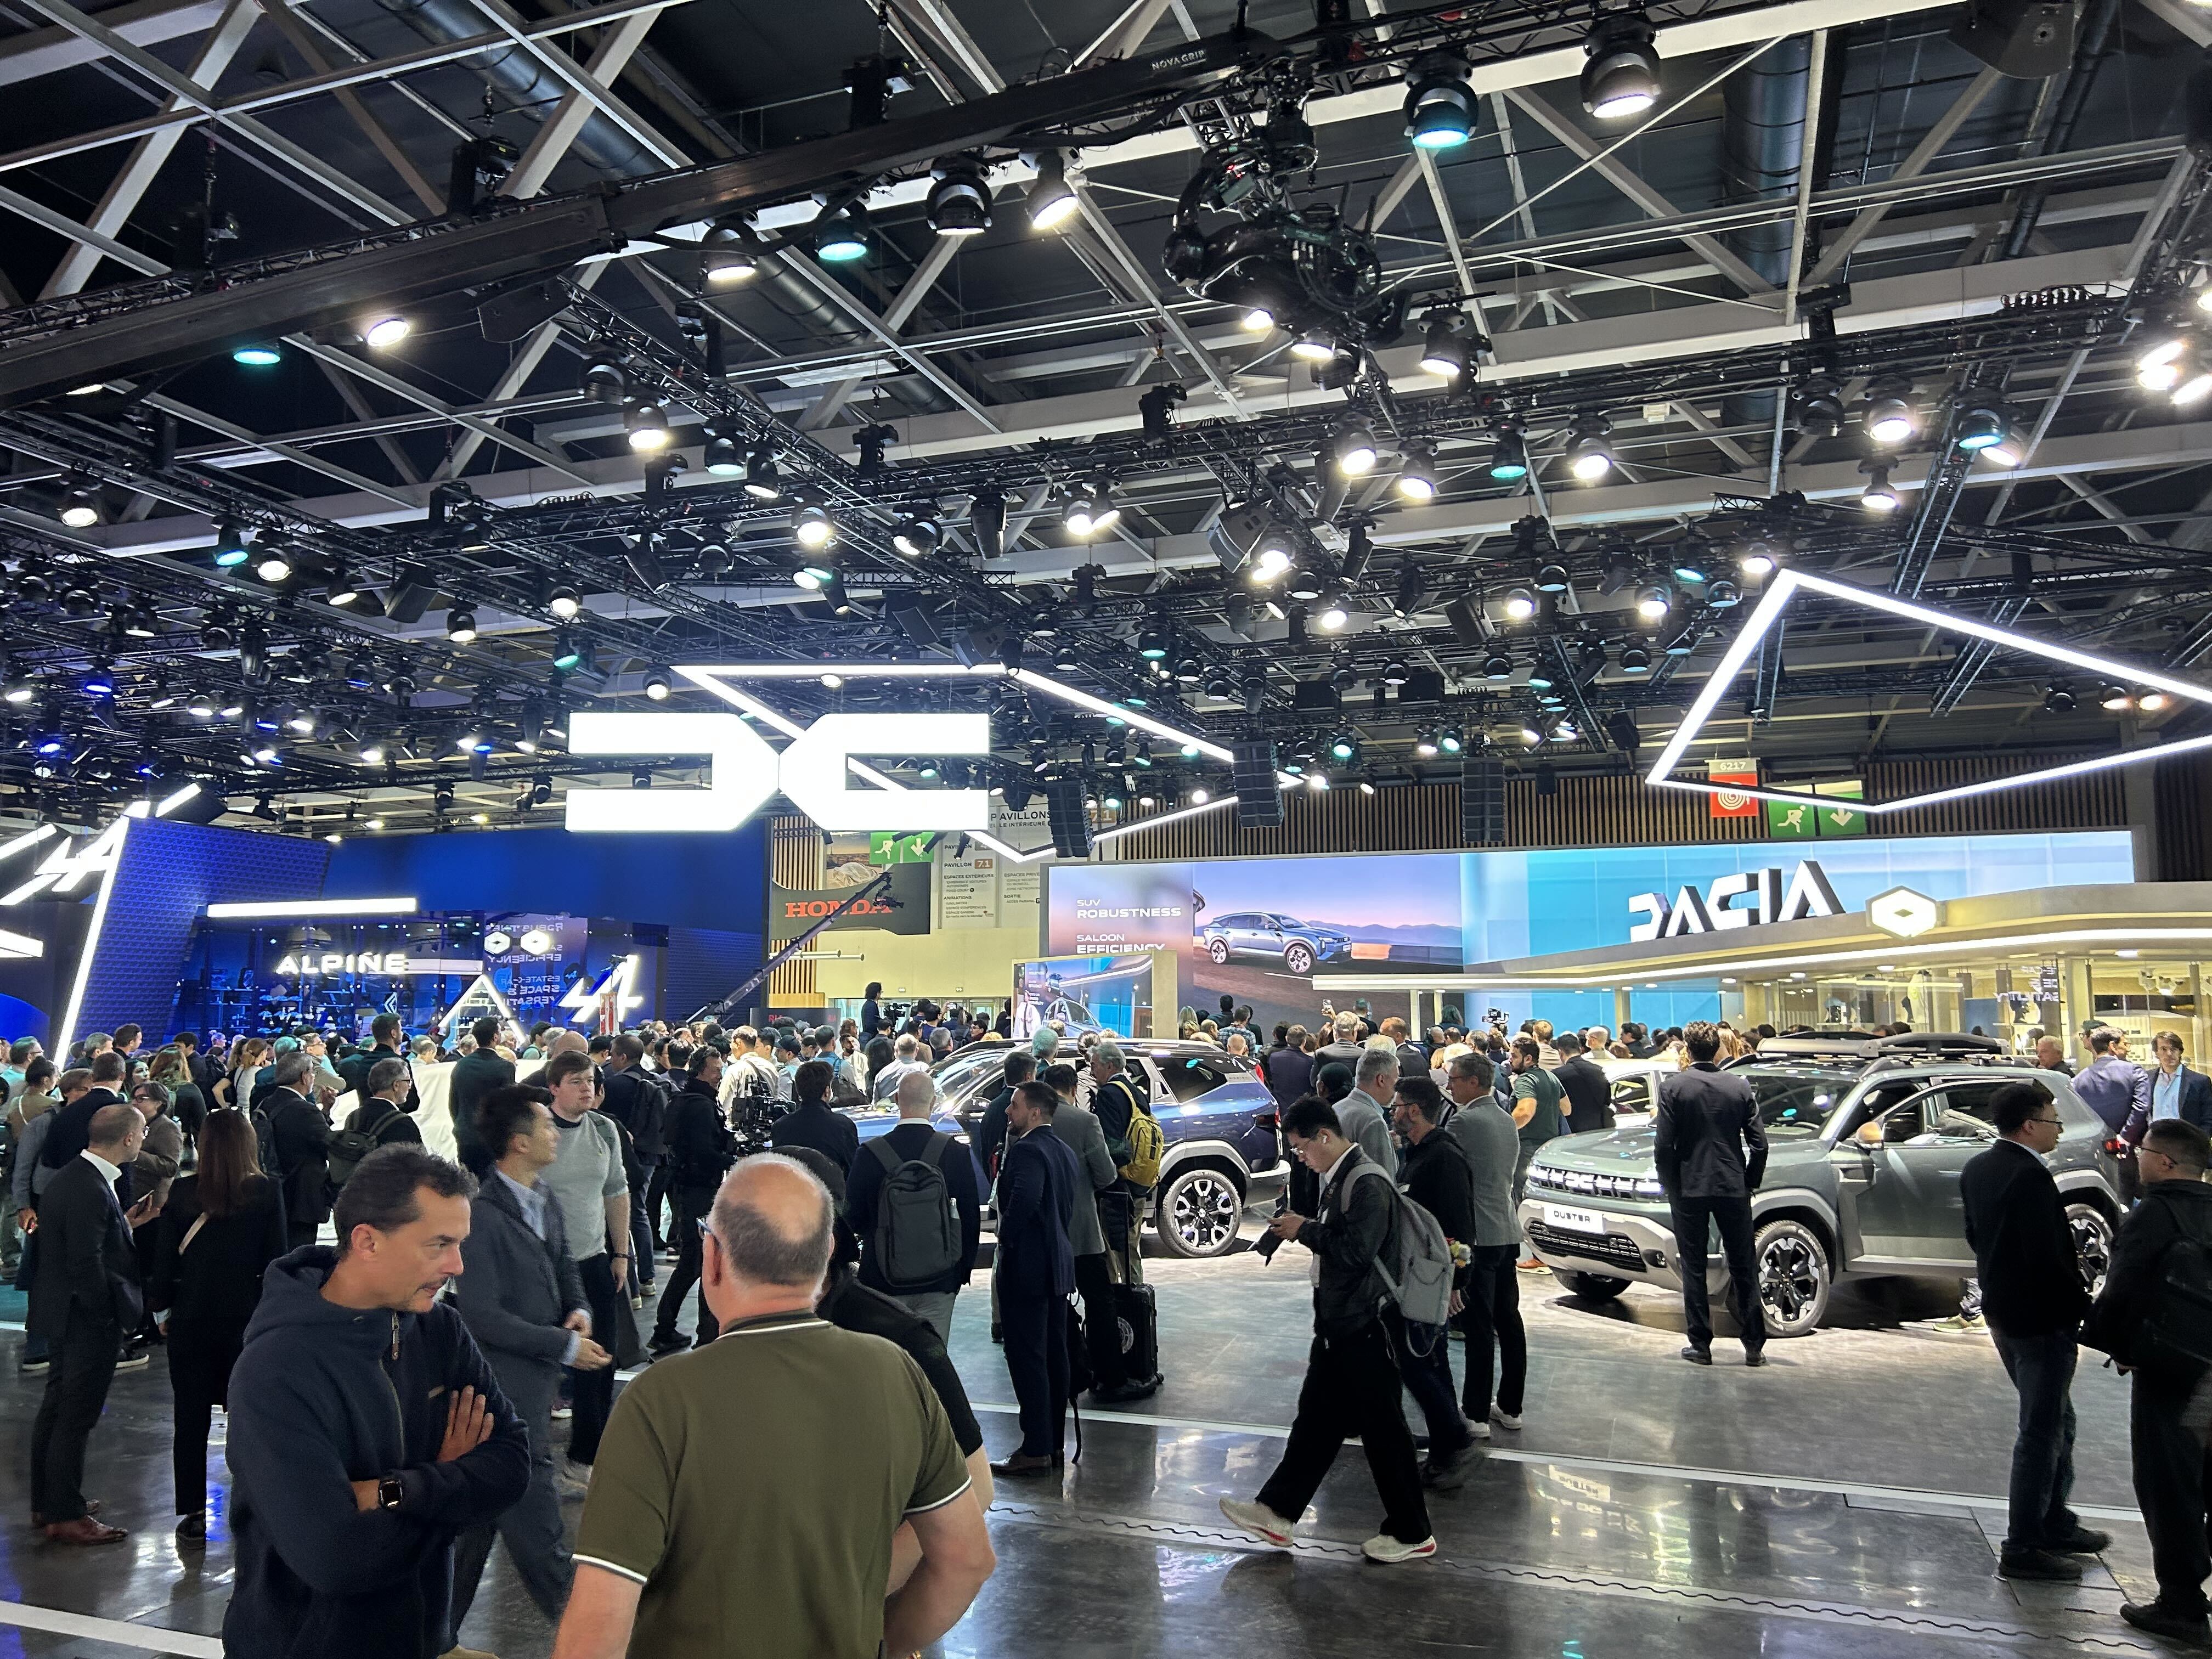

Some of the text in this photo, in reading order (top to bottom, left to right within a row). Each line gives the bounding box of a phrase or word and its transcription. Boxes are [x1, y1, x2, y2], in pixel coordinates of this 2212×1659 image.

[1720, 761, 1746, 771] 6217
[1090, 809, 1112, 822] 71
[977, 860, 990, 868] 7.1
[1628, 860, 1846, 943] DACIA
[1076, 907, 1181, 919] ROBUSTNESS
[1076, 934, 1125, 942] SALOON
[275, 953, 405, 974] ALPINE
[1554, 1210, 1590, 1223] DUSTER
